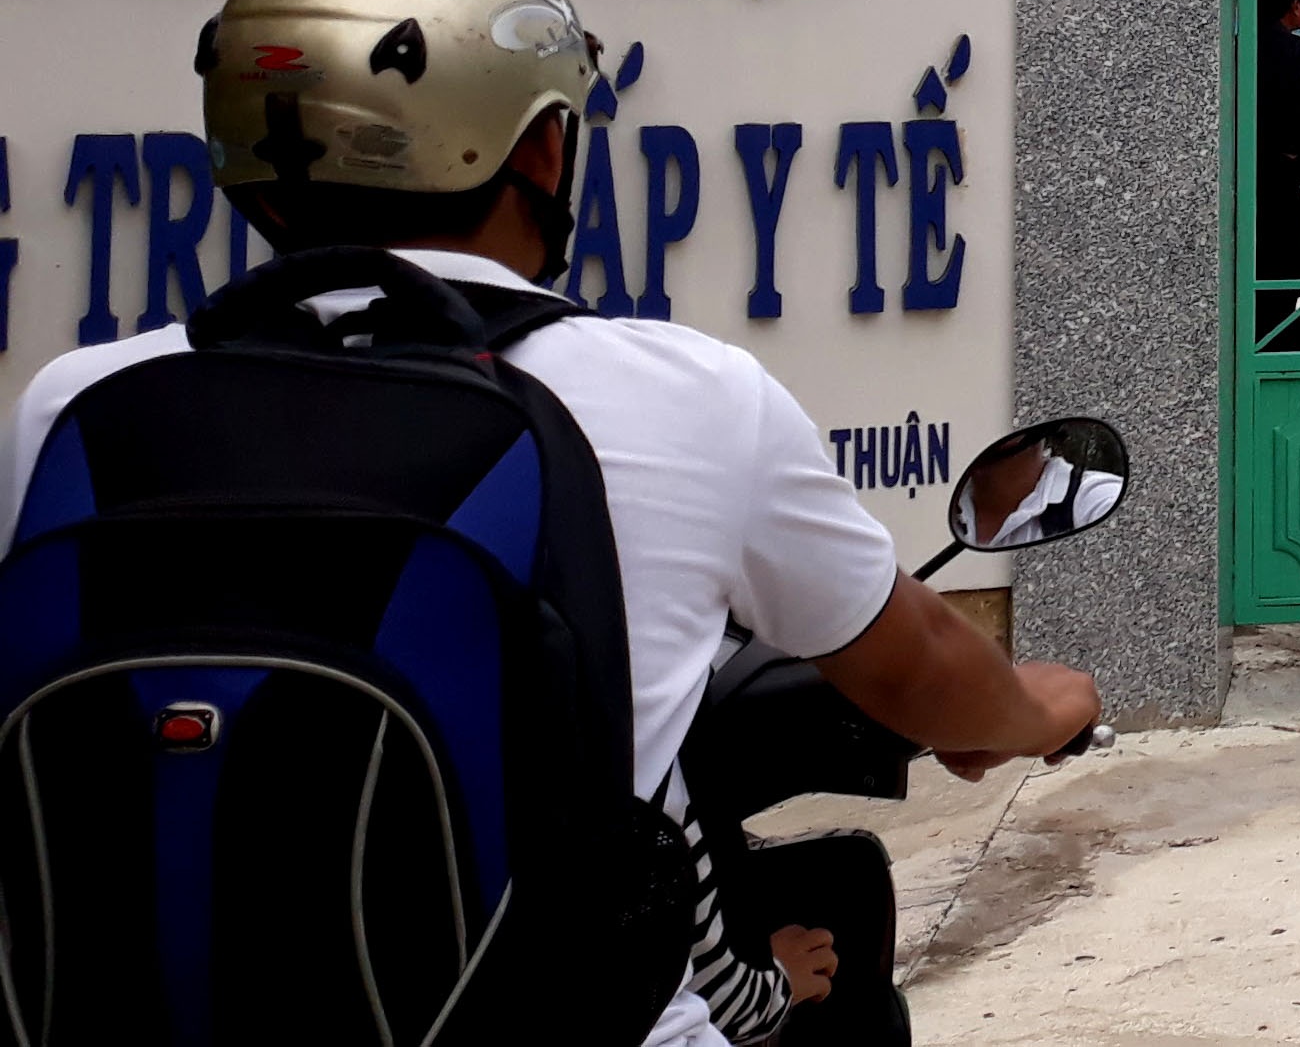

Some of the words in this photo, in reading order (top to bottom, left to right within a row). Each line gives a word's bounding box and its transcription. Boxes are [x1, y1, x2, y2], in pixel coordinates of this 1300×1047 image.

[734, 121, 803, 319] Y
[834, 33, 972, 314] TẾ
[829, 410, 950, 499] THUẬN
